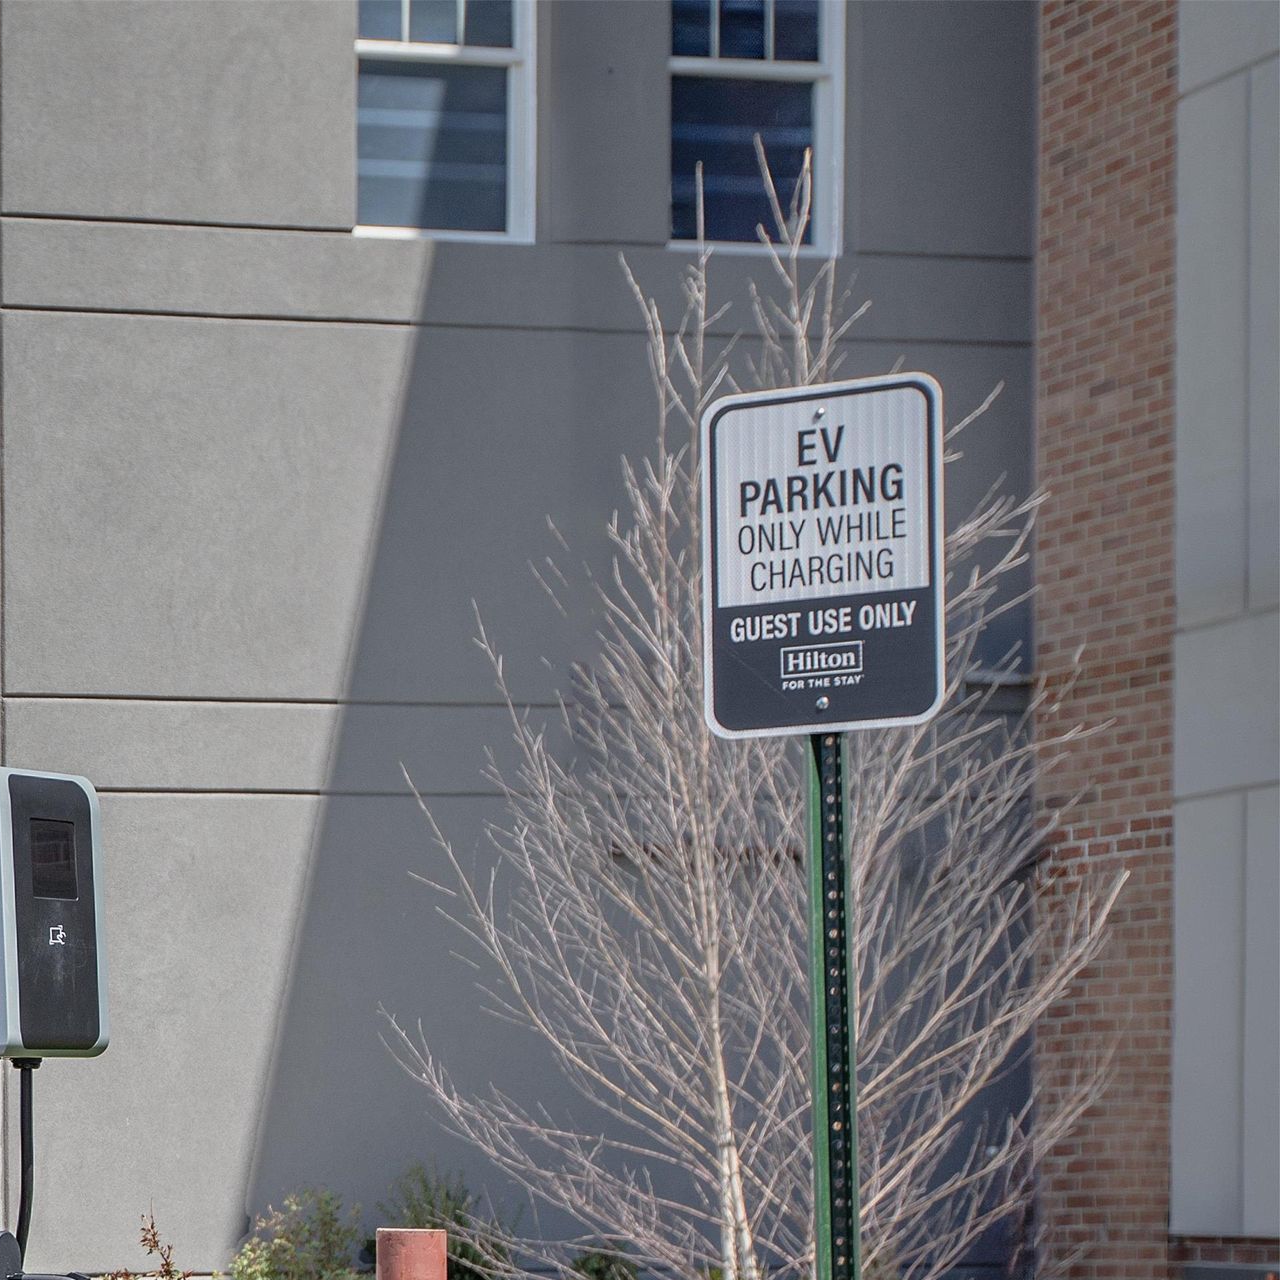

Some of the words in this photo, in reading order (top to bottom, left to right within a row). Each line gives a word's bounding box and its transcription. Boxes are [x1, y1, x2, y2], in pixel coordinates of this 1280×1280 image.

[797, 425, 844, 466] EV
[740, 463, 903, 518] PARKING
[739, 519, 806, 555] ONLY
[817, 508, 907, 546] WHILE
[751, 548, 894, 591] CHARGING
[730, 612, 801, 643] GUEST
[809, 607, 852, 635] USE
[859, 600, 917, 630] ONLY
[787, 650, 855, 672] Hilton
[782, 679, 806, 691] FOR
[808, 677, 832, 688] THE
[834, 675, 862, 687] STAY
